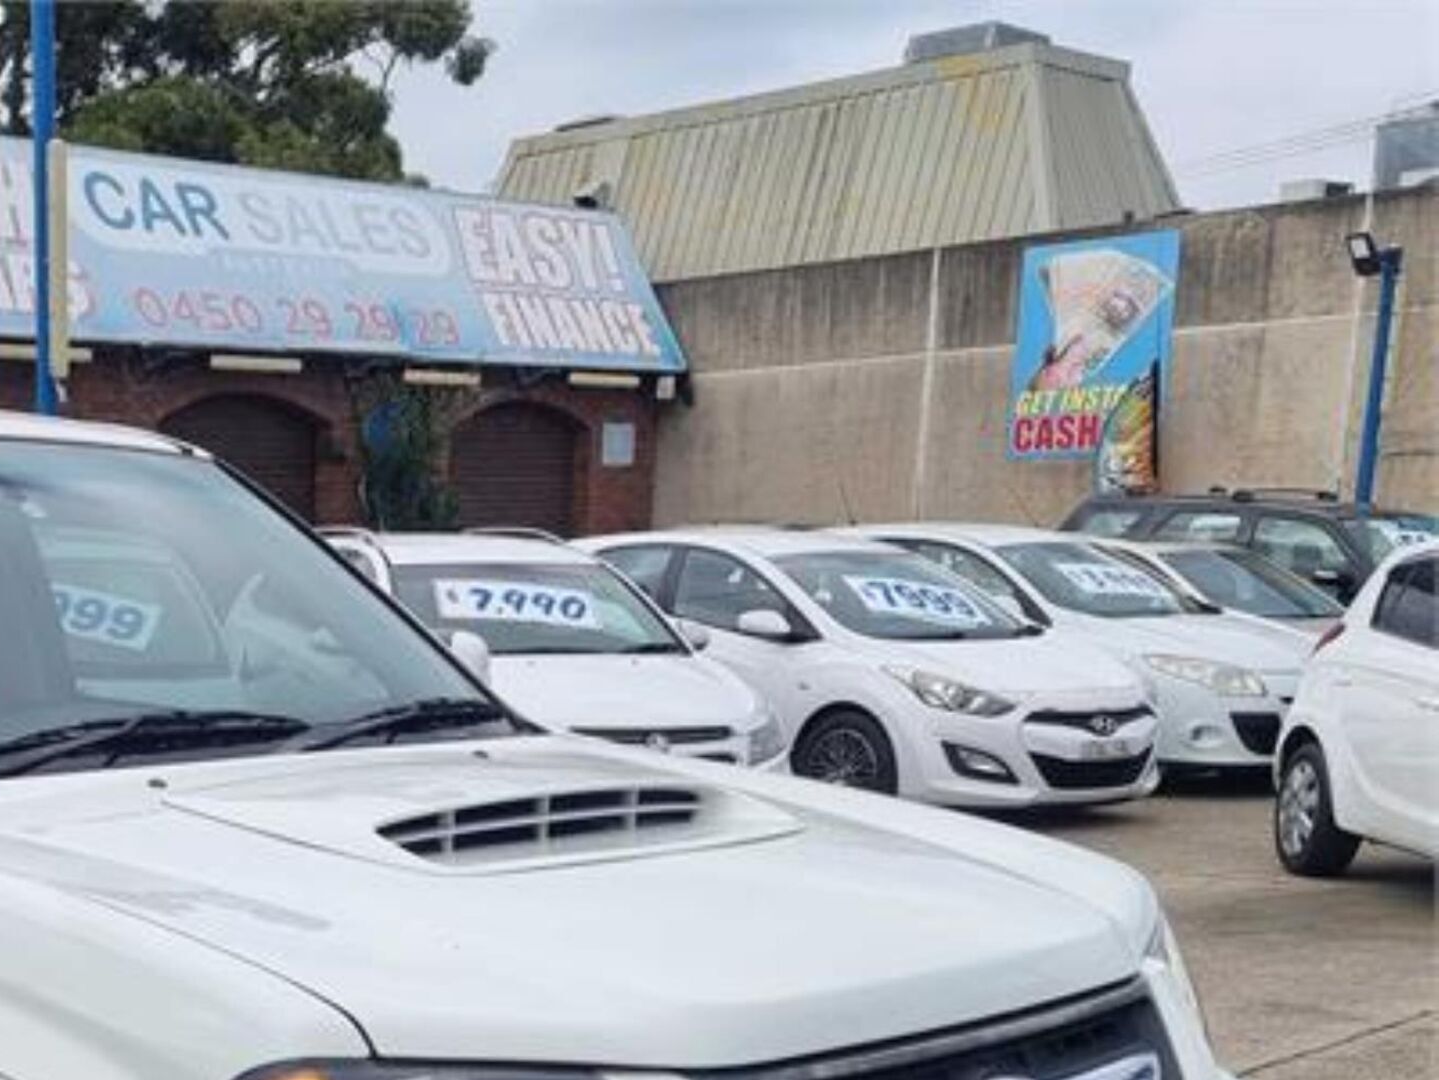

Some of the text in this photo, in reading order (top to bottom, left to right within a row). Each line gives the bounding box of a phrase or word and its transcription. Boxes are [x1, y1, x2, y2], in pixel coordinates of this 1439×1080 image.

[83, 172, 432, 260] CAR SALES
[456, 204, 624, 292] EASY!
[135, 286, 259, 332] 0450
[275, 296, 332, 339] 29
[410, 308, 460, 345] 29
[484, 293, 662, 357] FINANCE
[1014, 415, 1101, 453] CASH
